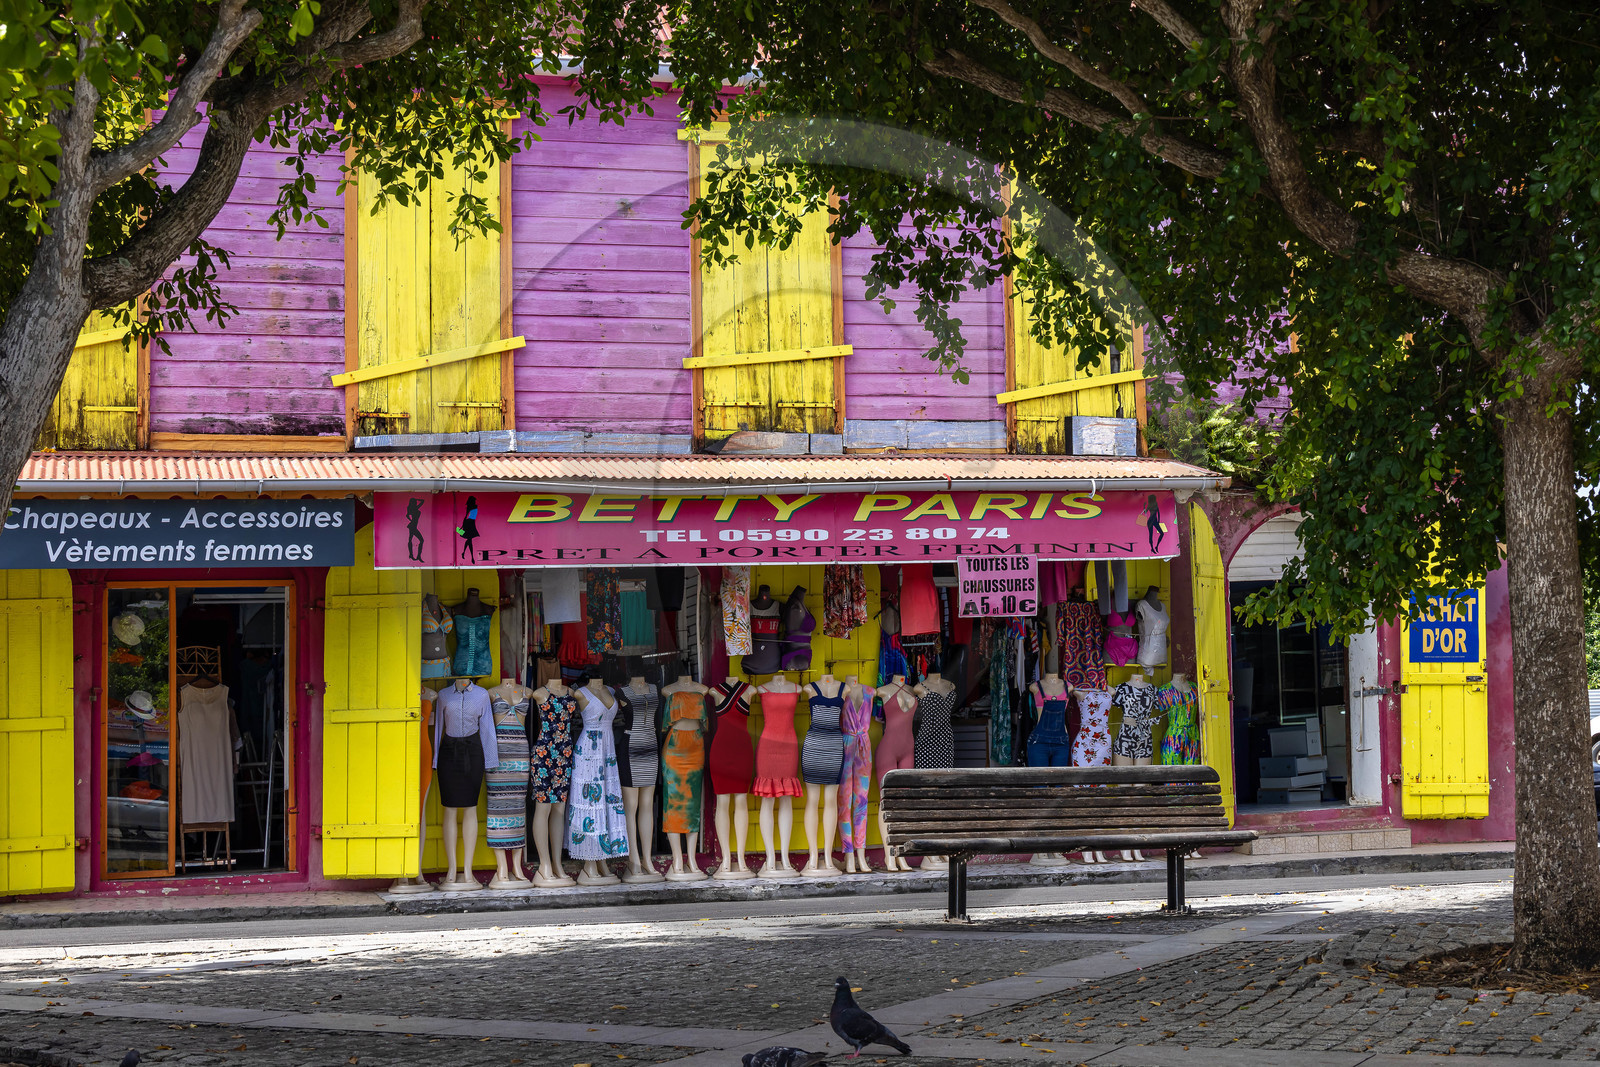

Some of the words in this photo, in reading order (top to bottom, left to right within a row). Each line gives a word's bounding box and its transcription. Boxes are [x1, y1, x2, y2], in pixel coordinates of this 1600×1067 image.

[507, 494, 824, 523] BETTY
[853, 493, 1105, 521] PARIS
[4, 507, 151, 534] Chapeaux
[180, 506, 343, 529] Accessoires
[639, 530, 708, 543] TEL
[718, 529, 829, 542] 0590
[843, 528, 893, 541] 23
[905, 527, 957, 540] 80
[967, 527, 1010, 539] 74
[45, 538, 196, 562] Vètements
[204, 539, 314, 561] femmes
[478, 548, 621, 561] PRET
[634, 547, 672, 559] A
[696, 545, 905, 558] PORTER
[919, 542, 1138, 556] FEMININ
[966, 557, 1008, 572] TOUTES
[1011, 557, 1029, 570] LES
[963, 578, 1035, 594] CHAUSSURES
[992, 607, 999, 615] et
